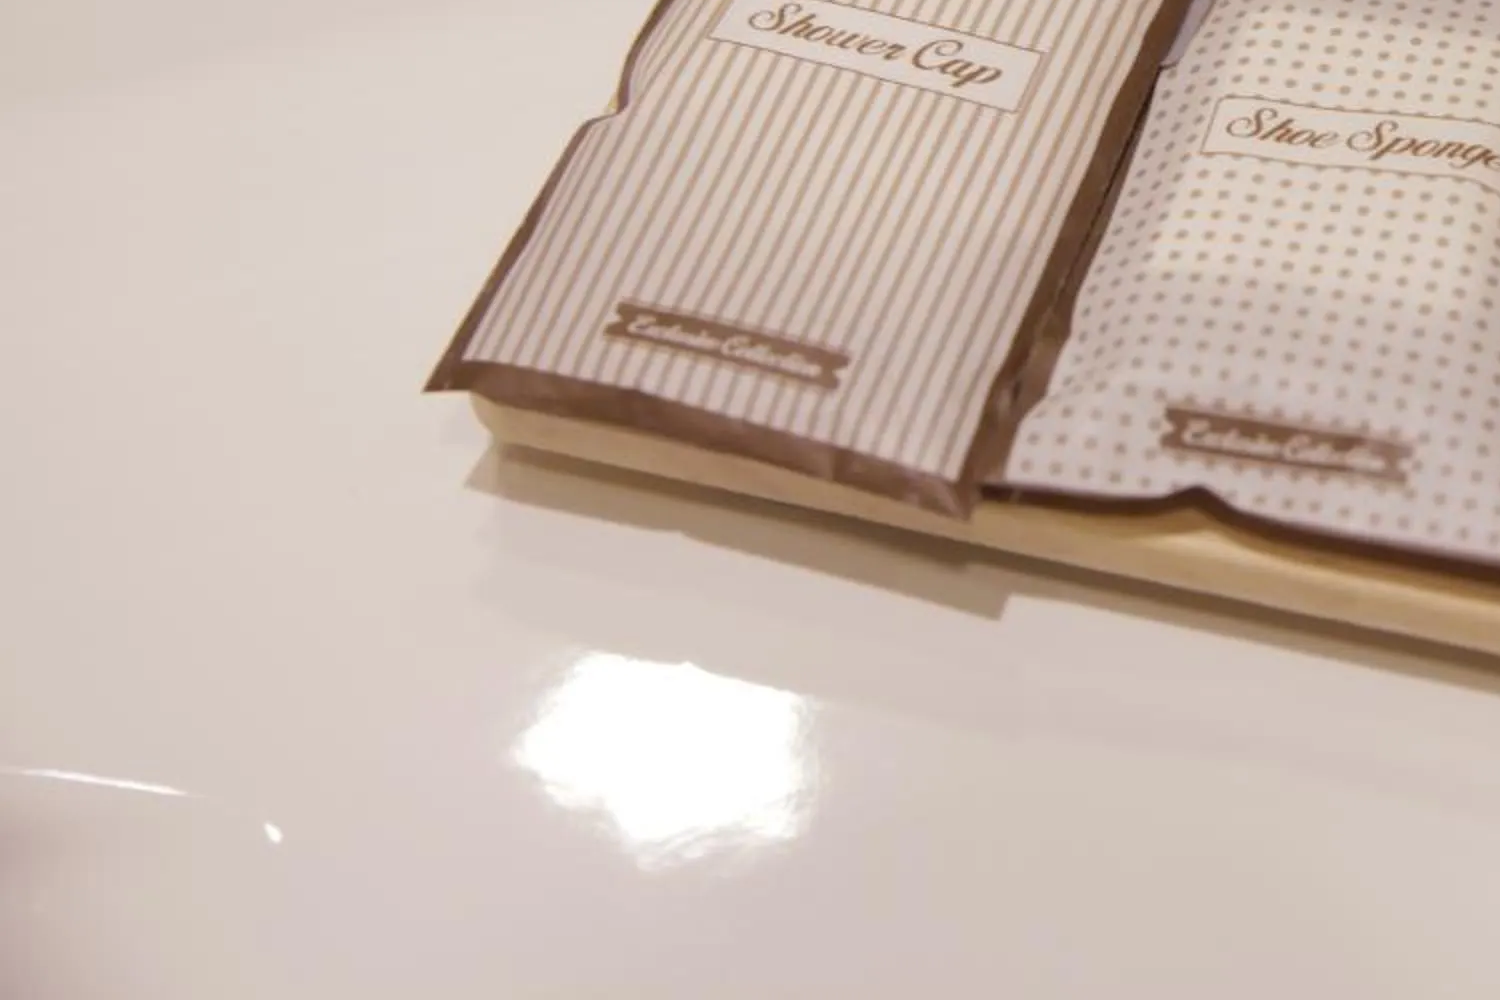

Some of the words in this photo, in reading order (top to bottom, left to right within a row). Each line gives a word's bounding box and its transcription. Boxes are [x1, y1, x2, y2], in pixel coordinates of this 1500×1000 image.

[748, 3, 907, 61] Shower
[911, 39, 1002, 88] Cap
[1225, 107, 1339, 149] Shoe
